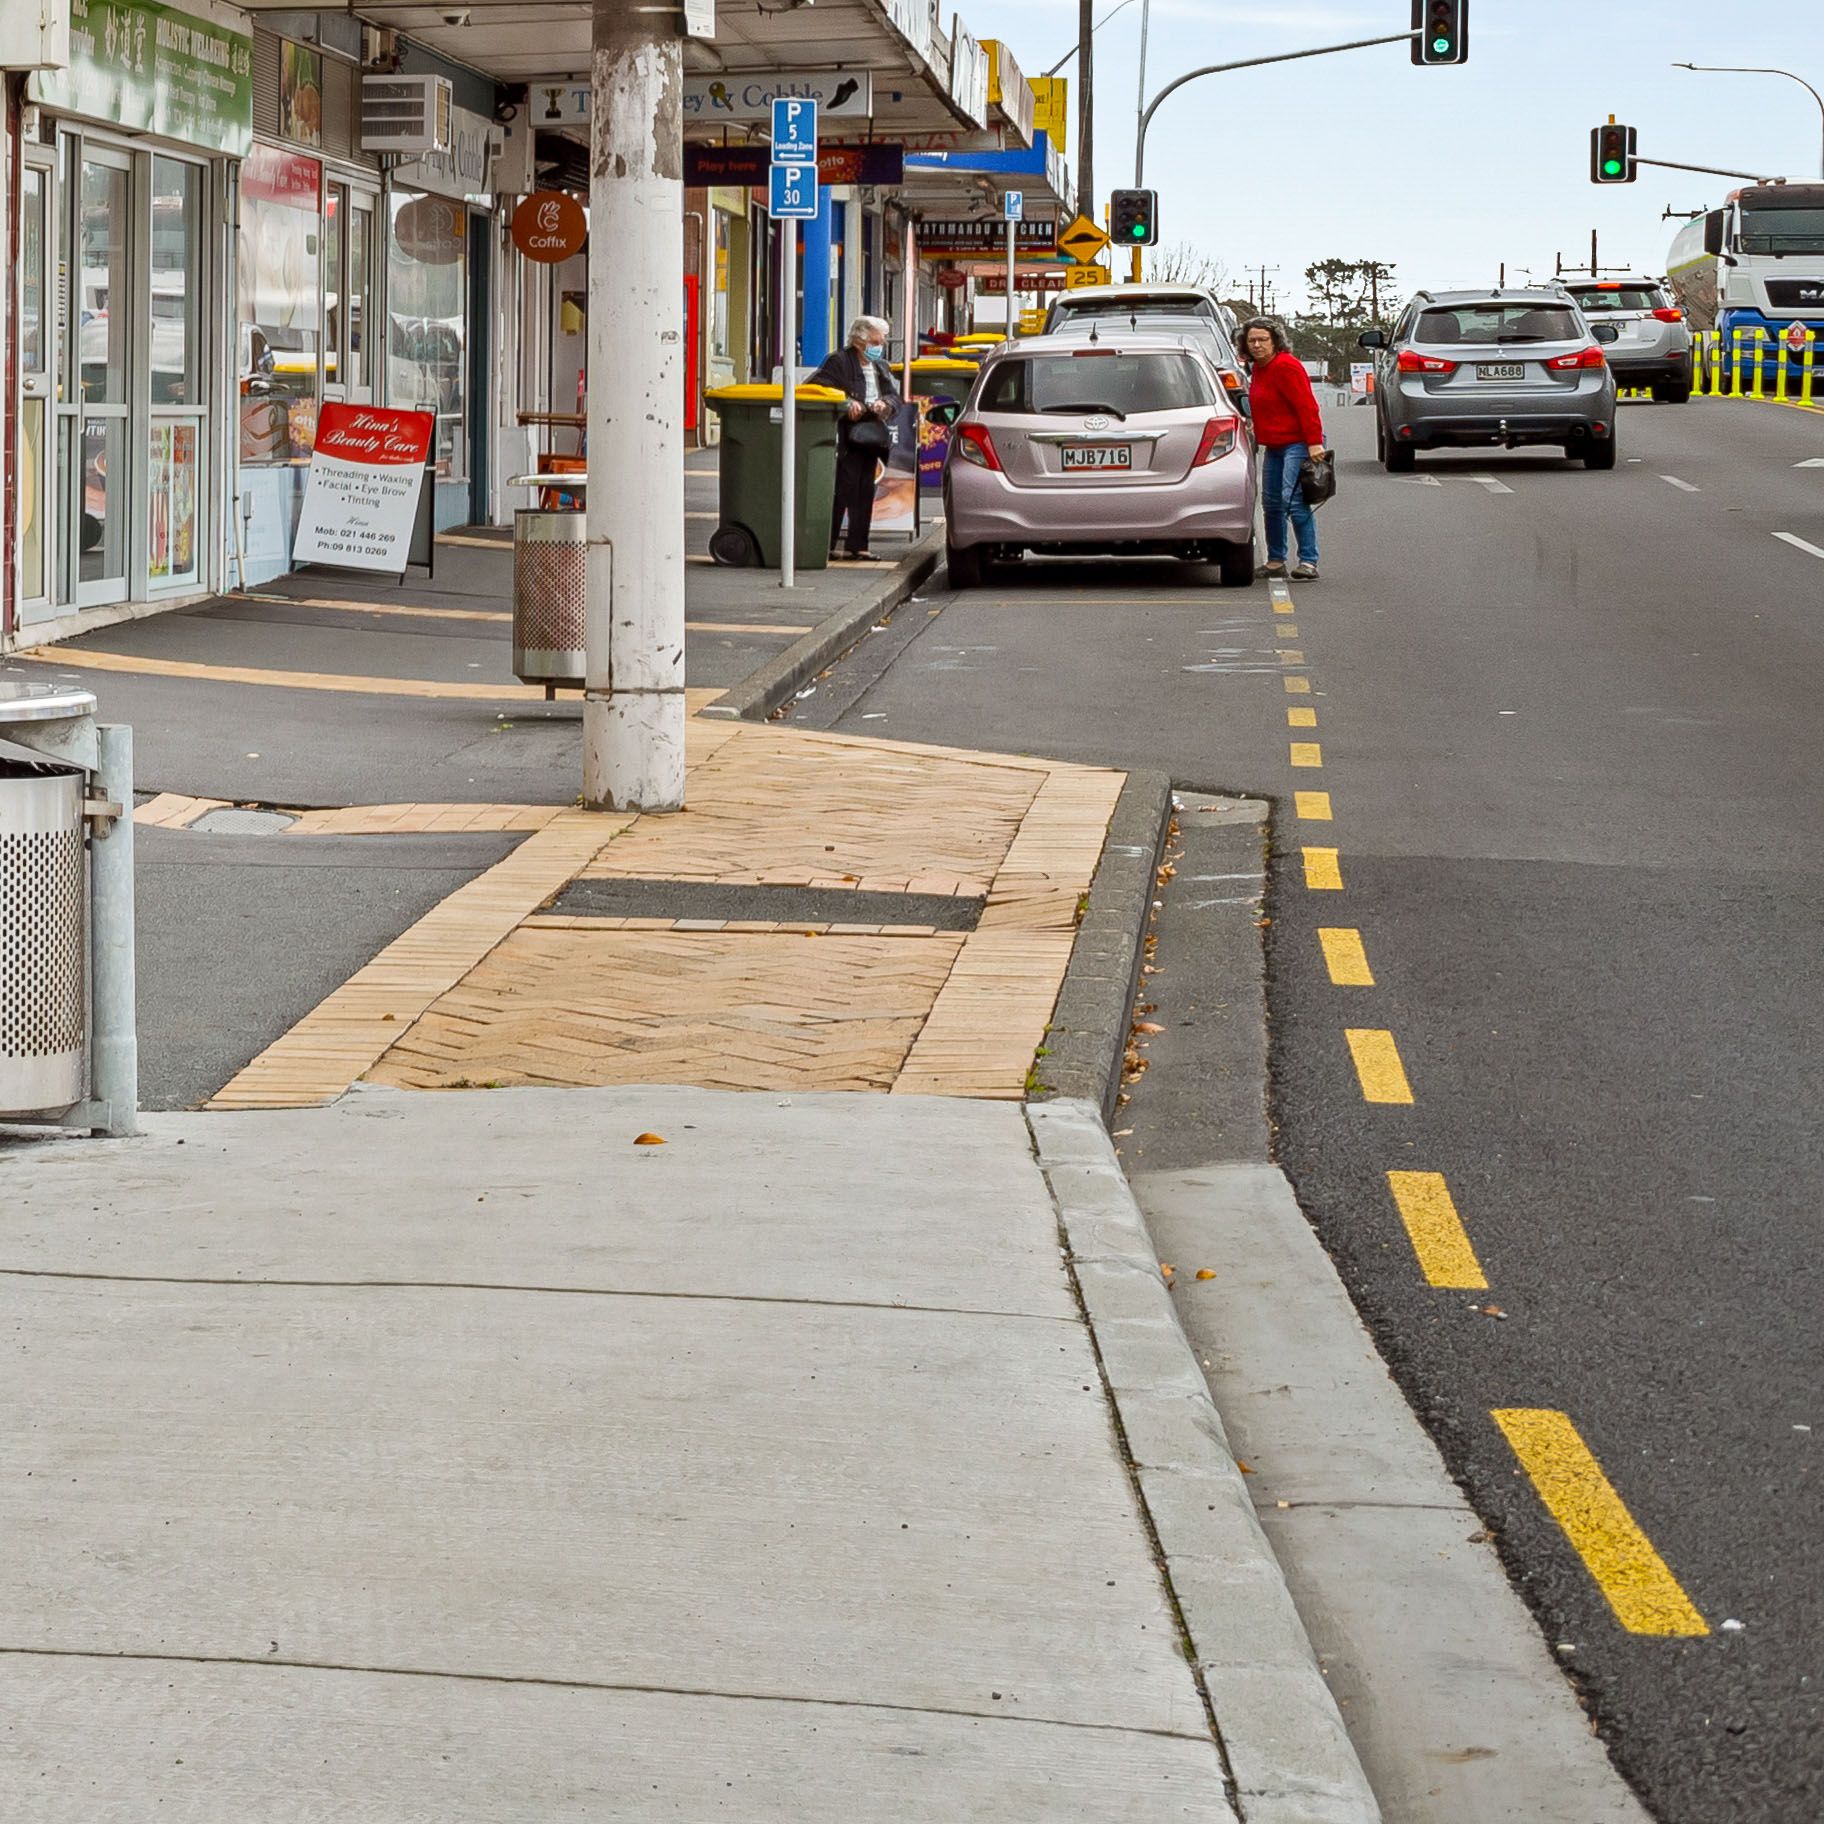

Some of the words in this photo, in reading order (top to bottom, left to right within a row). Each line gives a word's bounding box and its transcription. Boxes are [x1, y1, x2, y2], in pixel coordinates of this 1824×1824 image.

[156, 17, 190, 55] HOLISTIC
[787, 102, 802, 122] P
[789, 124, 798, 140] 5
[774, 141, 798, 152] Loading
[798, 141, 814, 151] Zone
[785, 167, 802, 188] P
[783, 189, 801, 205] 30
[915, 222, 991, 236] KATHMANDU
[997, 222, 1052, 236] KCHEN
[528, 235, 567, 250] Coffix
[1074, 271, 1098, 285] 25
[322, 428, 380, 452] Beauty
[383, 434, 419, 454] Care
[1065, 449, 1128, 465] MJB716
[321, 466, 370, 482] Threading
[379, 473, 414, 487] Waxing
[322, 479, 352, 491] Facial
[361, 485, 379, 495] Eye
[381, 486, 407, 497] Brow
[347, 494, 381, 508] Tinting
[314, 526, 339, 537] Mob:
[340, 529, 357, 539] 021
[359, 531, 376, 541] 446
[345, 545, 363, 554] 813
